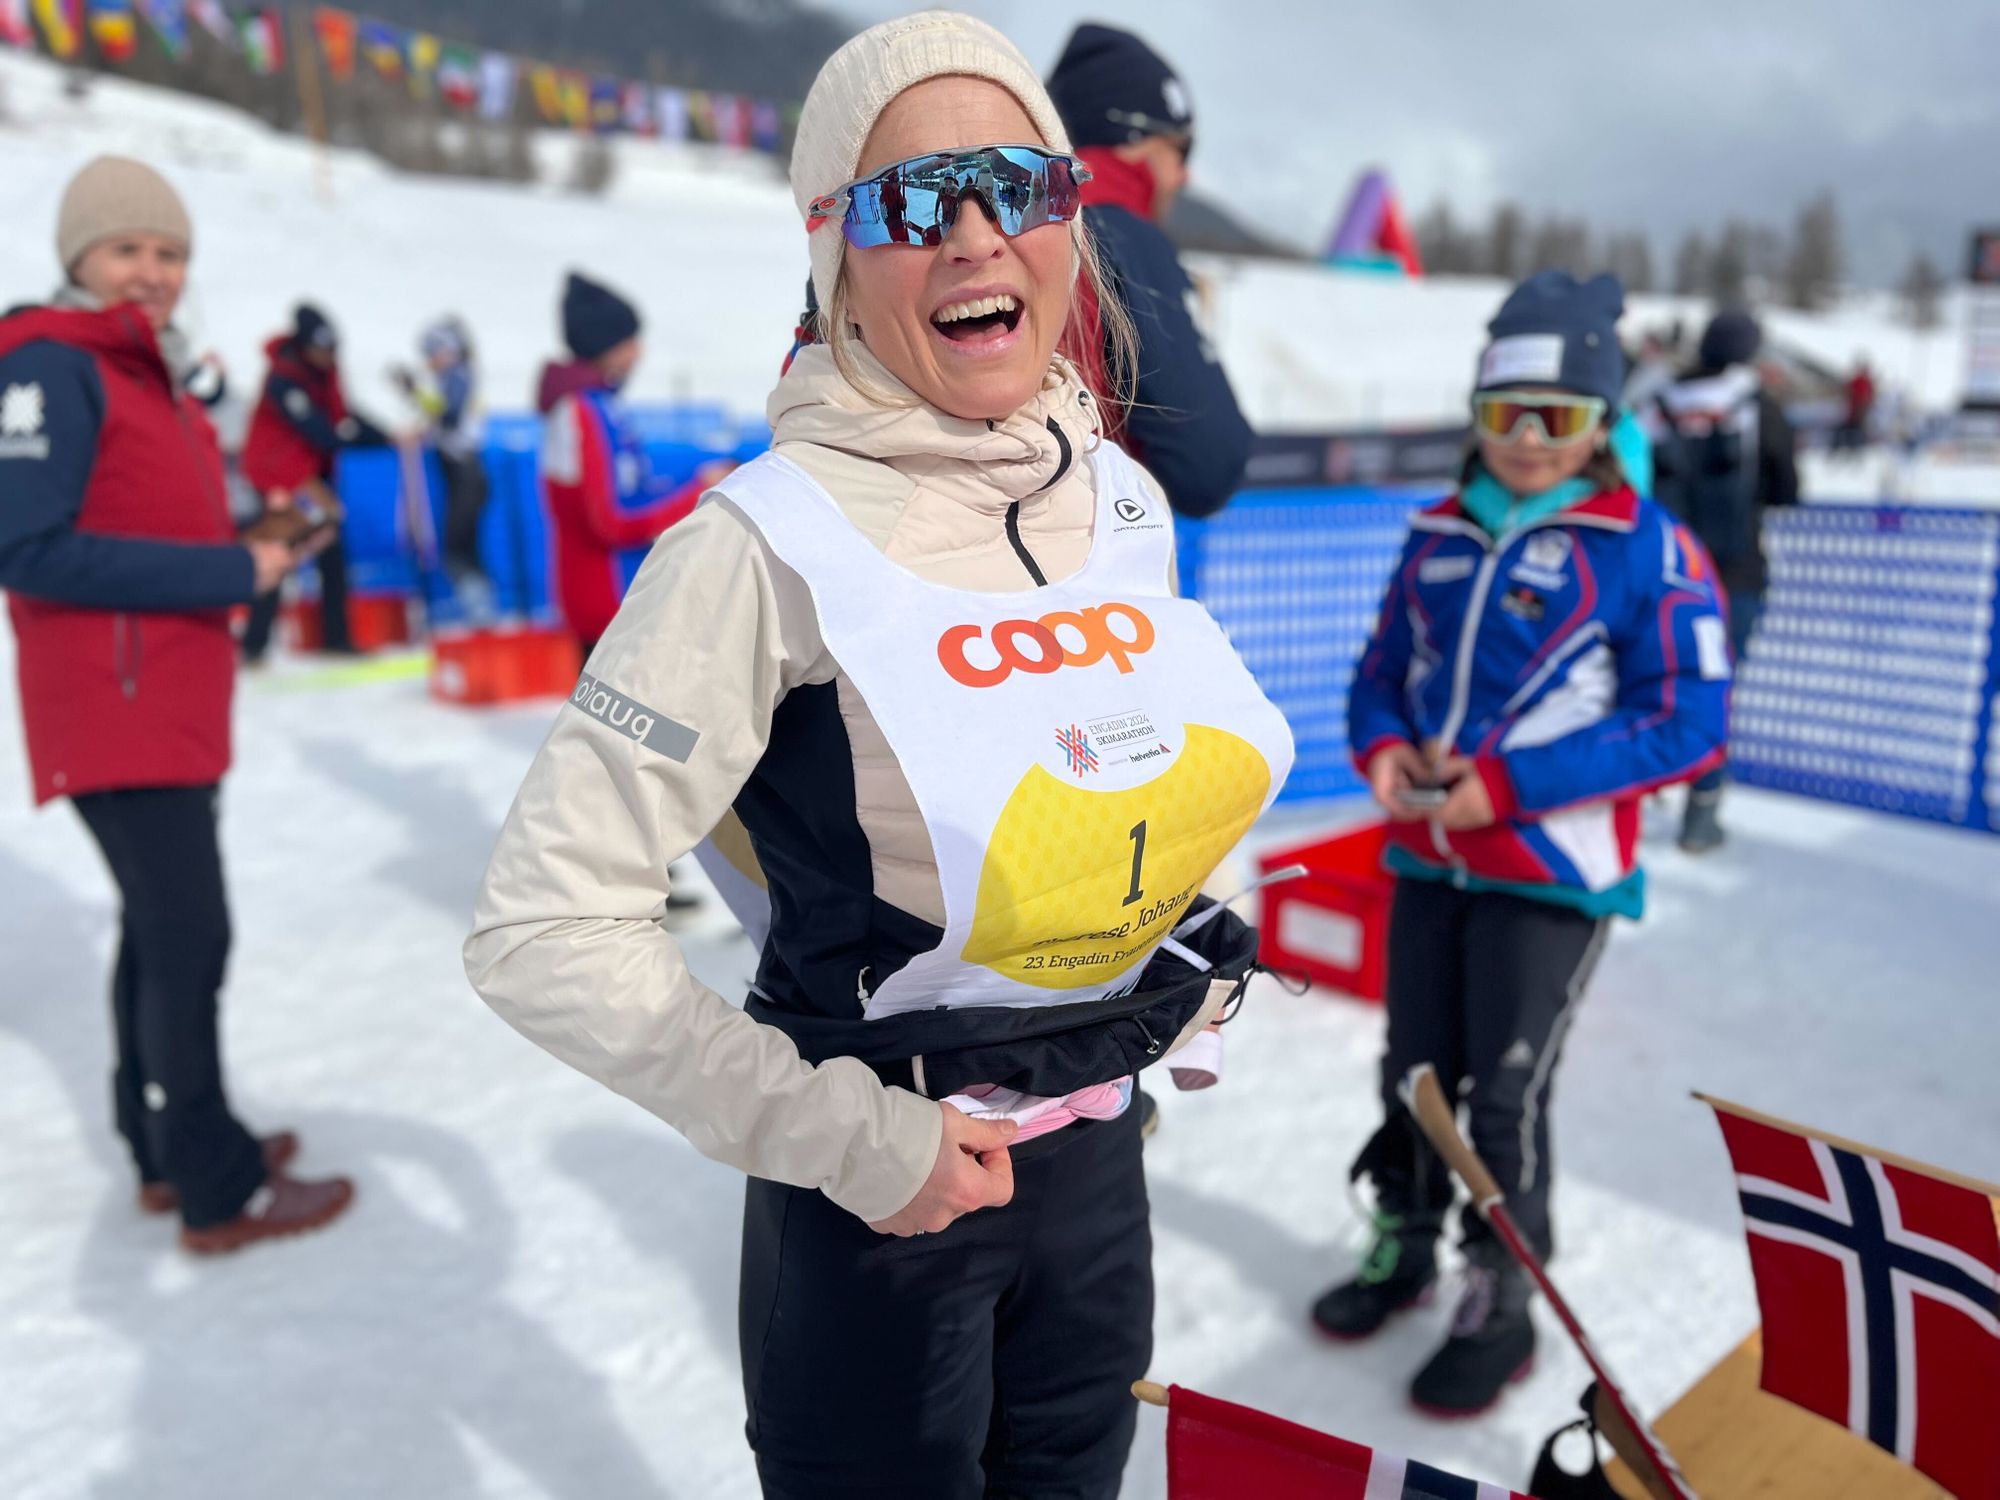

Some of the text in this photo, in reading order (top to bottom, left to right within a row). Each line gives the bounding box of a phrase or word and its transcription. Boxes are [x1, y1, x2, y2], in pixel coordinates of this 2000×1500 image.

[937, 602, 1156, 688] coop
[574, 679, 656, 744] ohaug
[1088, 713, 1150, 735] ENGADIN 2024
[1095, 724, 1156, 746] SKIMARATHON
[1128, 748, 1161, 763] helvetia
[1122, 819, 1147, 907] 1
[1031, 920, 1131, 948] erese
[1022, 955, 1045, 969] 23.
[1047, 951, 1110, 970] Engadin
